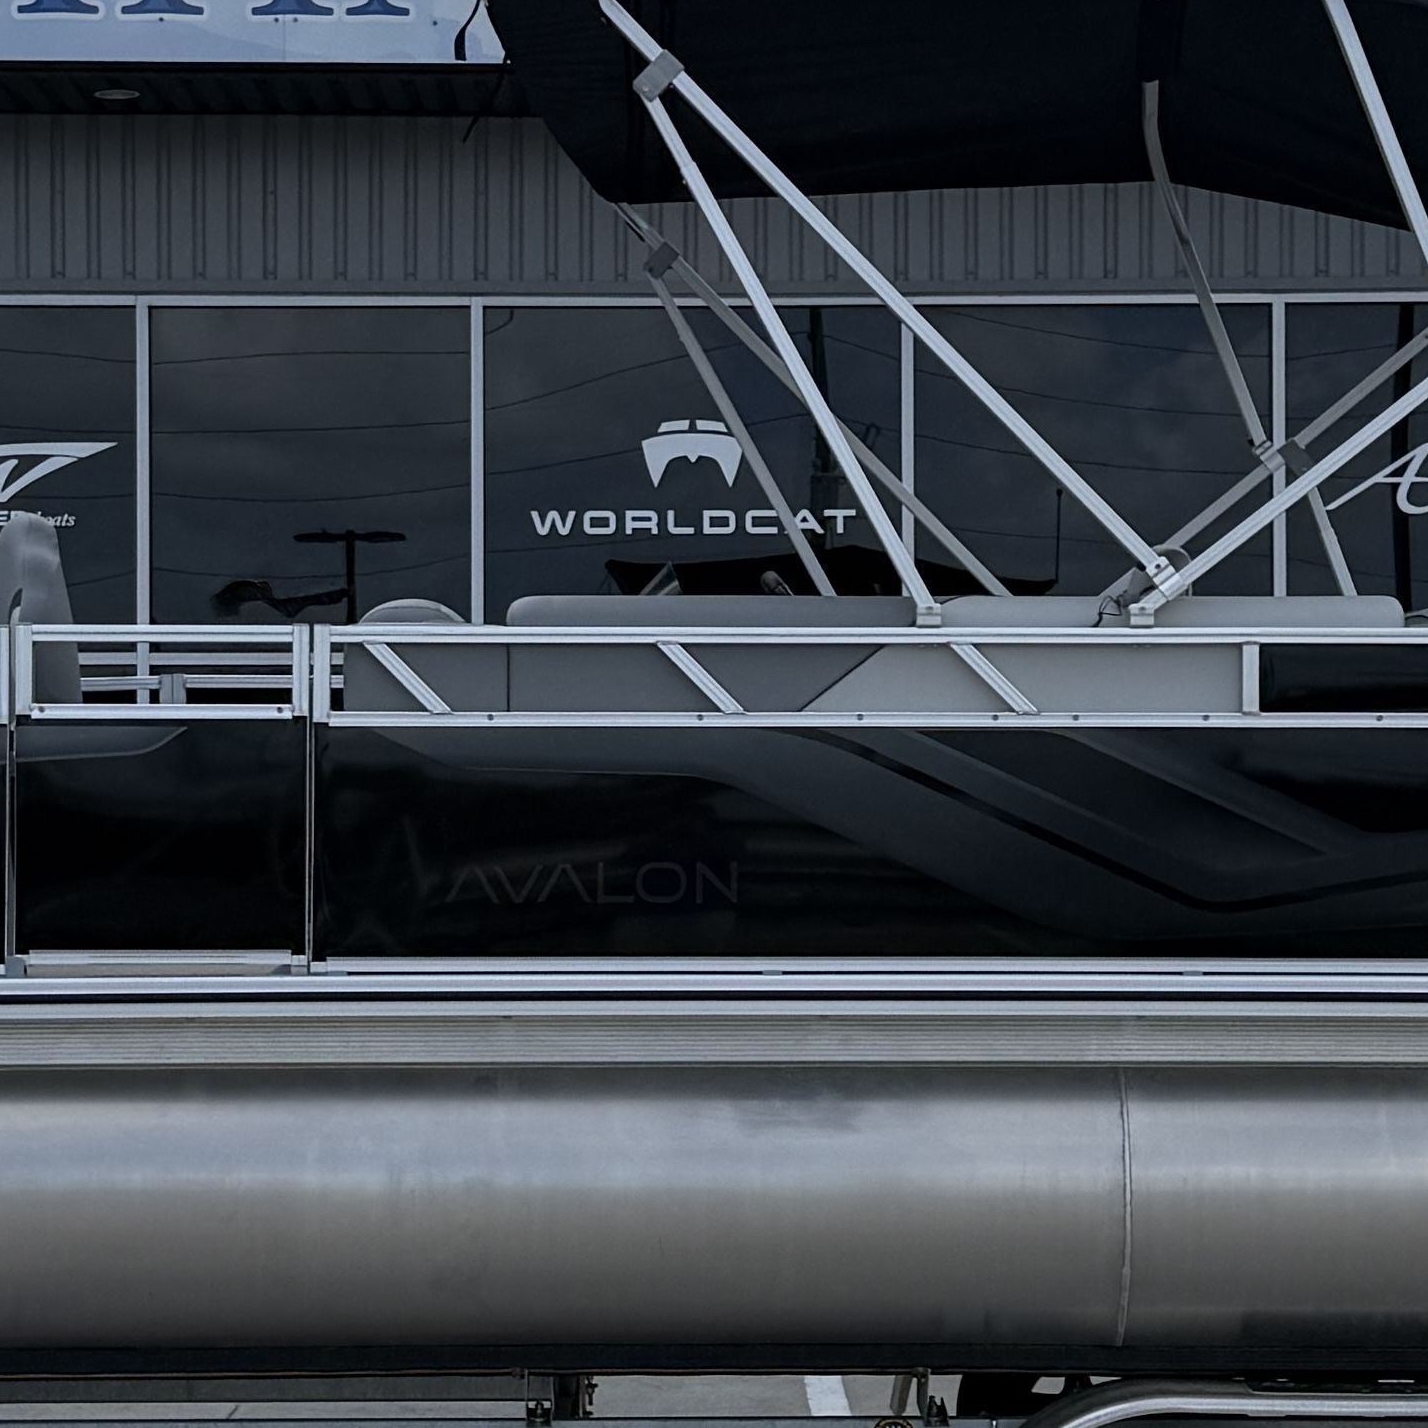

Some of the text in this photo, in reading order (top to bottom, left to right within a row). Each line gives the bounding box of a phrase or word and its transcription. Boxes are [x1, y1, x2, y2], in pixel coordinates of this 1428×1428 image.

[38, 511, 76, 528] oats
[529, 508, 857, 536] WORLDCAT
[444, 860, 740, 905] AVALON
